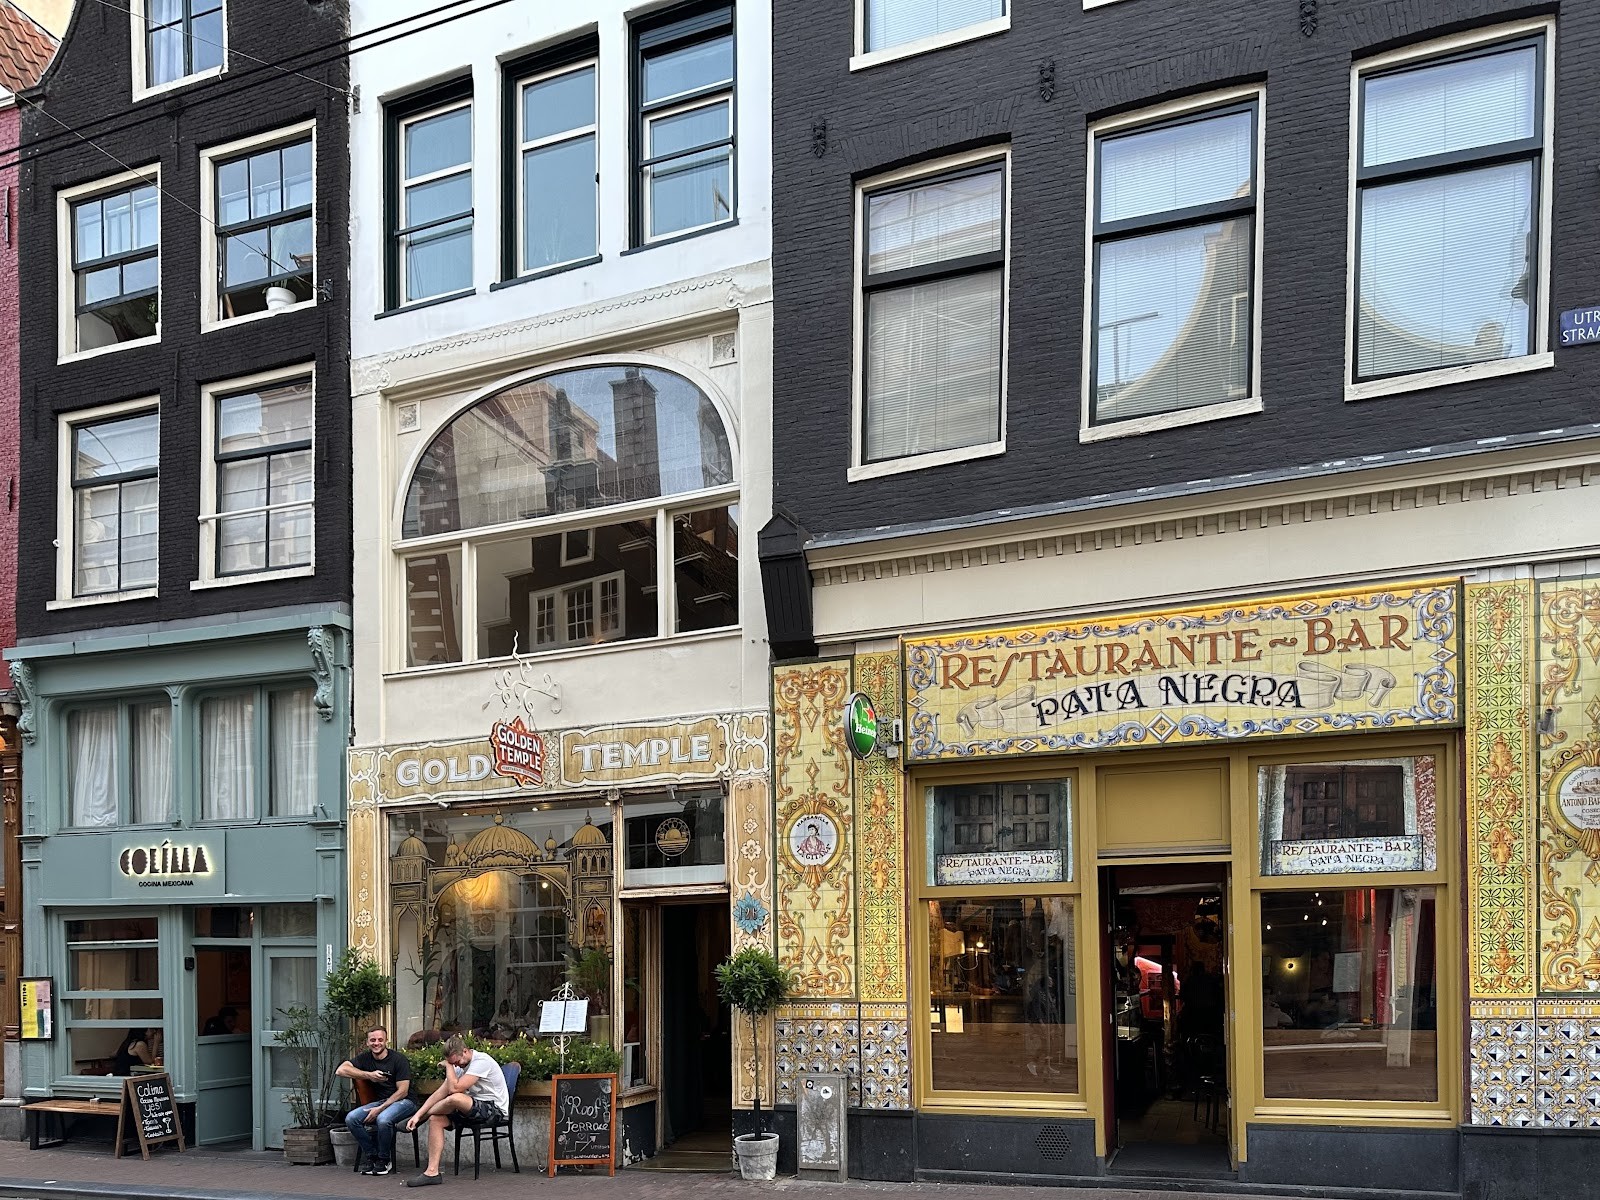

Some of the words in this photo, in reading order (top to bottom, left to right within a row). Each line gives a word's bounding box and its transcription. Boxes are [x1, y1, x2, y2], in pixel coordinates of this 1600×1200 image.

[1031, 679, 1147, 727] PATA
[1158, 672, 1306, 709] NEGRA
[497, 725, 540, 754] GOLDEN
[499, 744, 541, 772] TEMPLE
[571, 733, 712, 773] TEMPLE
[967, 866, 995, 878] PATA
[998, 865, 1031, 877] NEGRA
[1308, 855, 1342, 867] PATA
[1345, 853, 1385, 866] NEGRA
[137, 1083, 164, 1097] Colima
[564, 1095, 601, 1119] Roof
